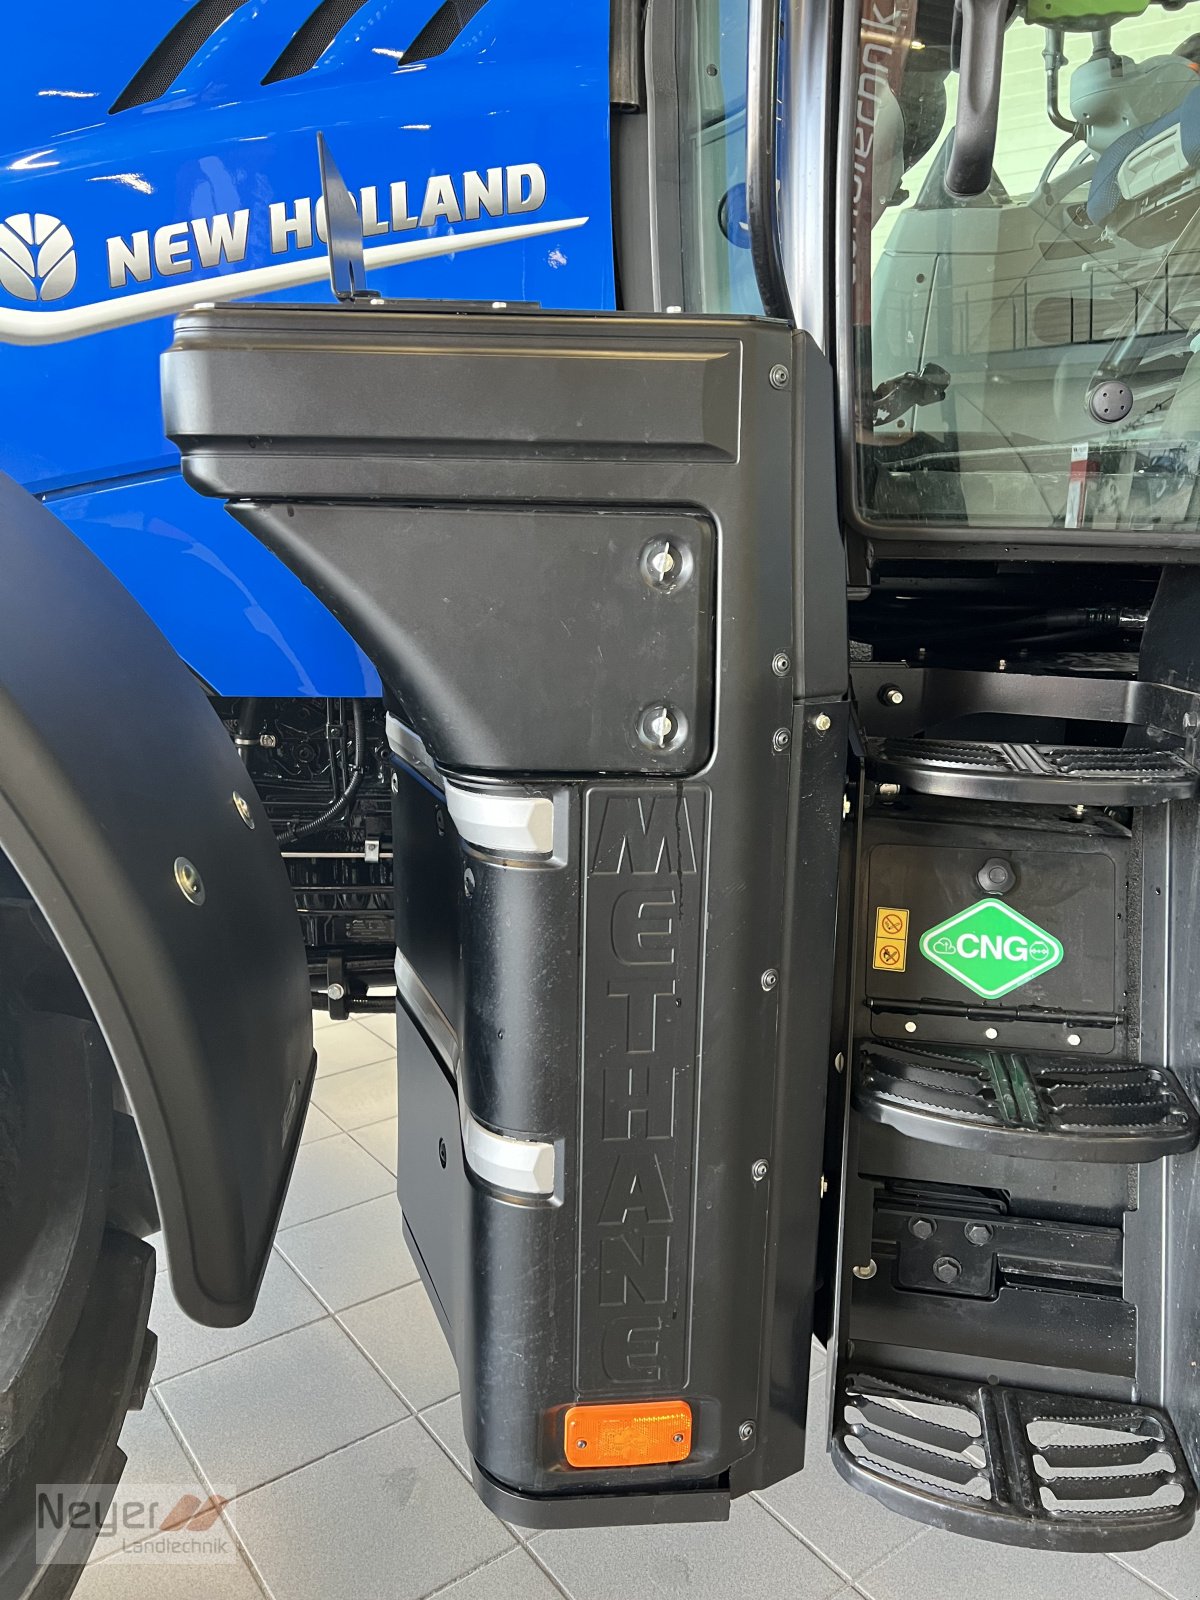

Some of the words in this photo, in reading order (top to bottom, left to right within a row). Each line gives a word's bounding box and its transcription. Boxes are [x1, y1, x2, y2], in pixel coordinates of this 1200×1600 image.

[106, 209, 250, 289] NEW
[956, 933, 1029, 962] CNG
[591, 796, 697, 1383] METHANE
